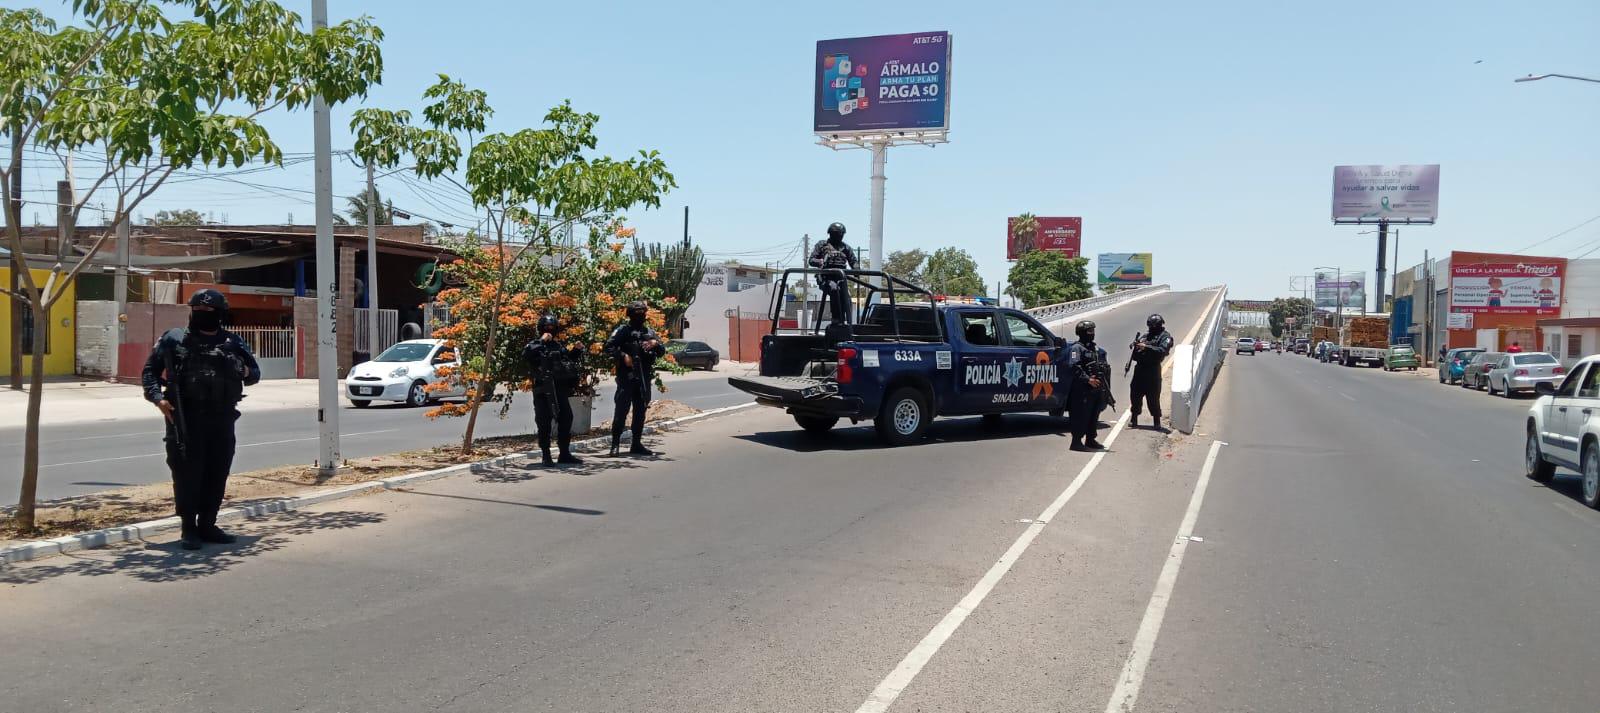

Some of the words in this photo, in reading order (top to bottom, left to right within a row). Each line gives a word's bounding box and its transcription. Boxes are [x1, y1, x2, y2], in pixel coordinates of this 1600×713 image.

[913, 36, 931, 44] AT&T
[880, 62, 940, 76] ÁRMALO
[880, 84, 920, 98] PAGA
[922, 84, 938, 96] $0
[894, 350, 922, 361] 633A
[965, 360, 1001, 385] POLICÍA
[1025, 364, 1059, 384] ESTATAL
[992, 393, 1029, 403] SINALOA
